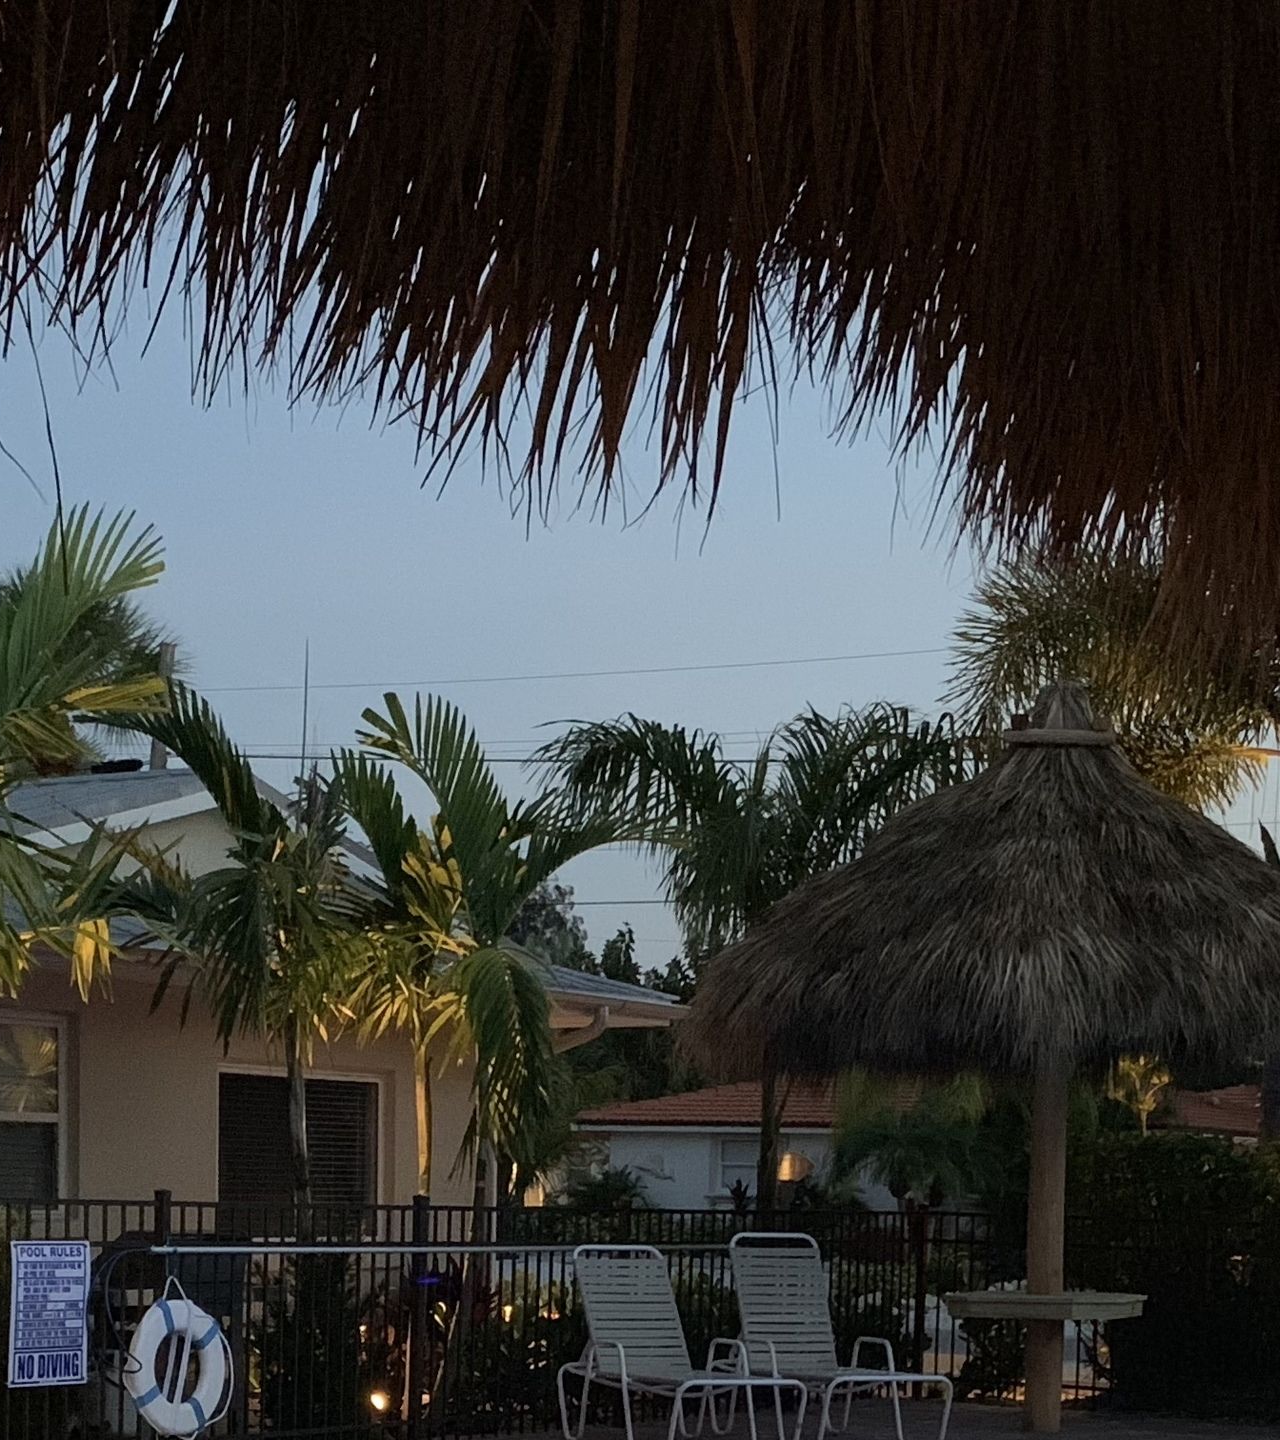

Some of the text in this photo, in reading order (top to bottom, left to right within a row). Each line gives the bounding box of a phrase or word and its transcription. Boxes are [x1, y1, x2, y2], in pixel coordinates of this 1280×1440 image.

[20, 1247, 82, 1257] POOL RULES
[17, 1352, 79, 1379] NO DIVING
